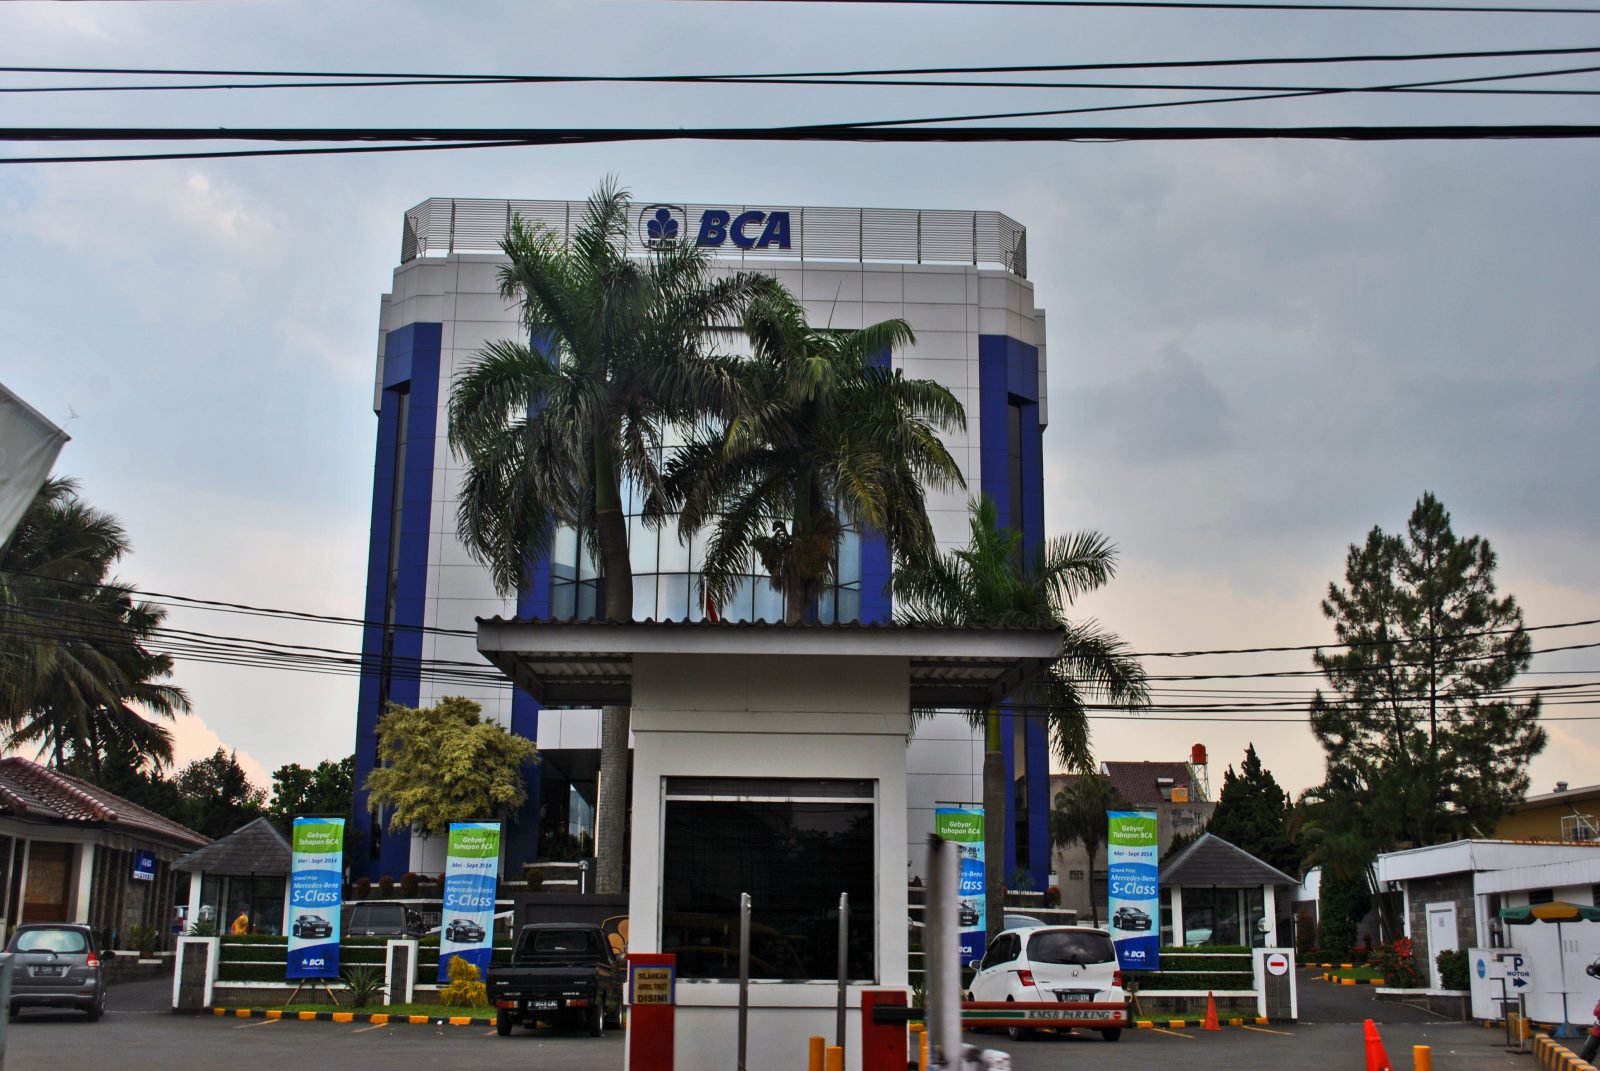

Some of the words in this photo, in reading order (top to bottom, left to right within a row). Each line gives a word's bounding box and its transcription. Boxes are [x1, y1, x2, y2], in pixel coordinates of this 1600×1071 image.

[696, 209, 791, 250] BCA
[462, 836, 486, 844] Gebyar
[959, 878, 983, 891] lass
[1111, 874, 1156, 882] Mercedes-Benz
[1111, 882, 1156, 895] S-Class
[293, 889, 338, 902] S-Class
[445, 894, 492, 907] S-Class
[309, 958, 325, 966] BCA
[1513, 957, 1524, 971] P
[637, 994, 668, 1003] DISINI
[1028, 1010, 1060, 1019] KMSB
[1062, 1010, 1110, 1019] PARKING
